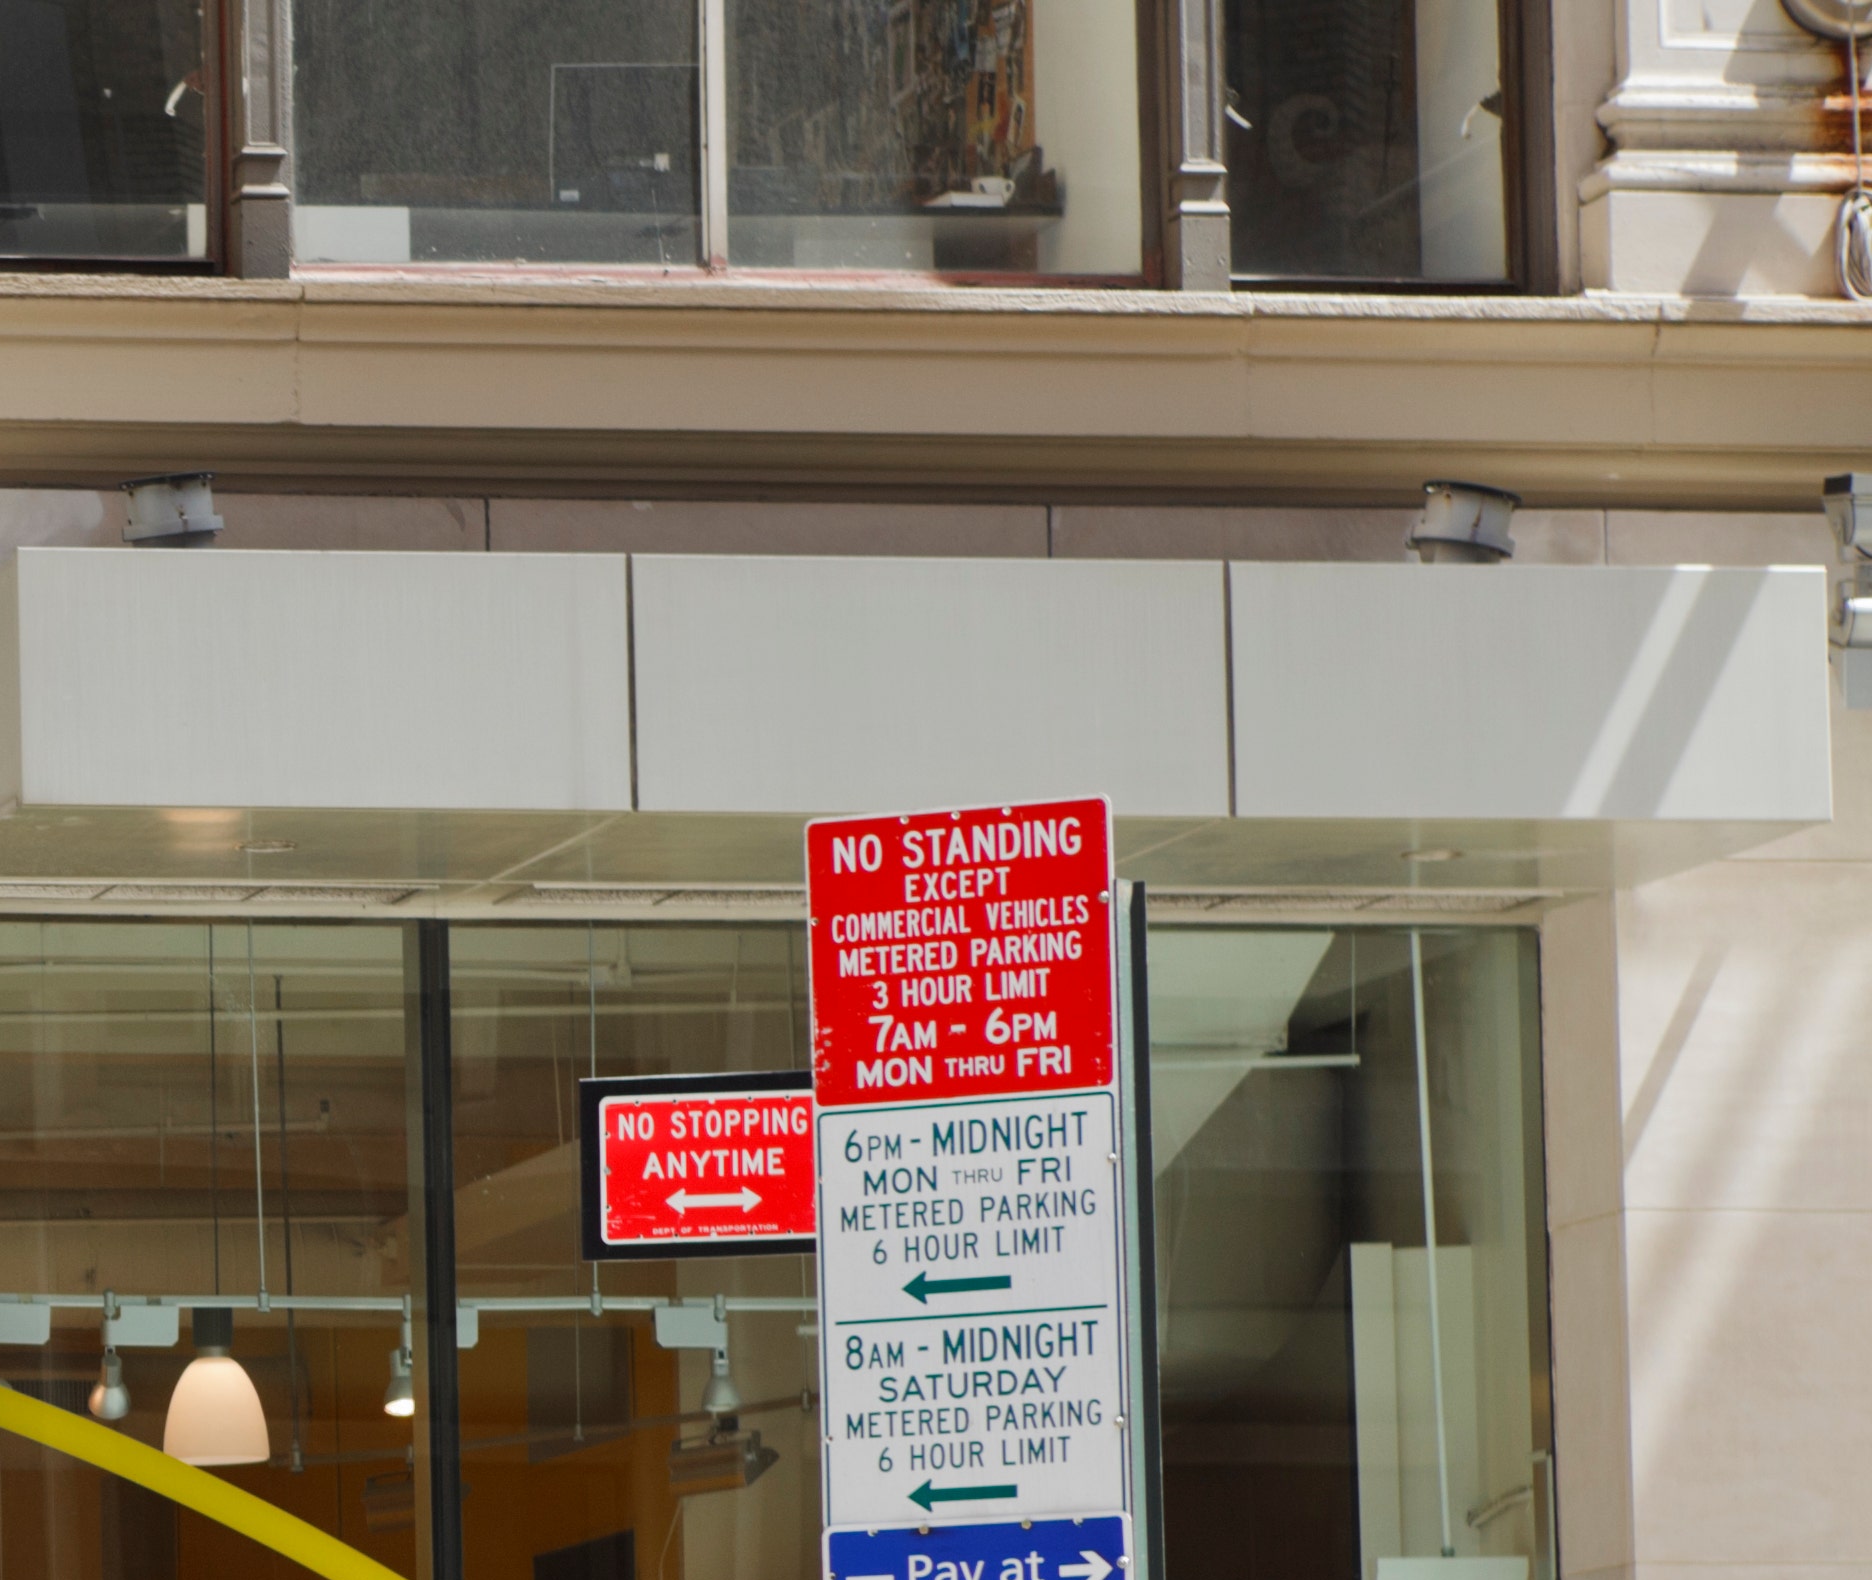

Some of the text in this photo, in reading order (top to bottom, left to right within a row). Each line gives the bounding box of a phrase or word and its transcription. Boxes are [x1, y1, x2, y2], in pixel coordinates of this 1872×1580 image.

[832, 817, 1082, 874] NO STANDING
[904, 866, 1012, 903] EXCEPT
[831, 894, 1090, 944] COMMERCIAL VEHICLES
[838, 930, 1083, 978] METERED PARKING
[872, 968, 1051, 1010] 3 HOUR LIMIT
[867, 1014, 938, 1053] 7AM
[984, 1006, 1058, 1045] 6PM
[856, 1045, 1072, 1090] MON THRU FRI
[617, 1106, 809, 1141] NO STOPPING
[843, 1129, 903, 1164] 6PM
[932, 1111, 1089, 1158] MIDNIGHT
[642, 1147, 786, 1180] ANYTIME
[862, 1156, 1072, 1197] MON THRU FRI
[840, 1188, 1096, 1233] METERED PARKING
[872, 1225, 1065, 1265] 6 HOUR LIMIT
[844, 1335, 904, 1370] 8AM
[942, 1320, 1099, 1365] MIDNIGHT
[878, 1365, 1067, 1403] SATURDAY
[846, 1398, 1102, 1440] METERED PARKING
[878, 1435, 1071, 1473] 6 HOUR LIMIT
